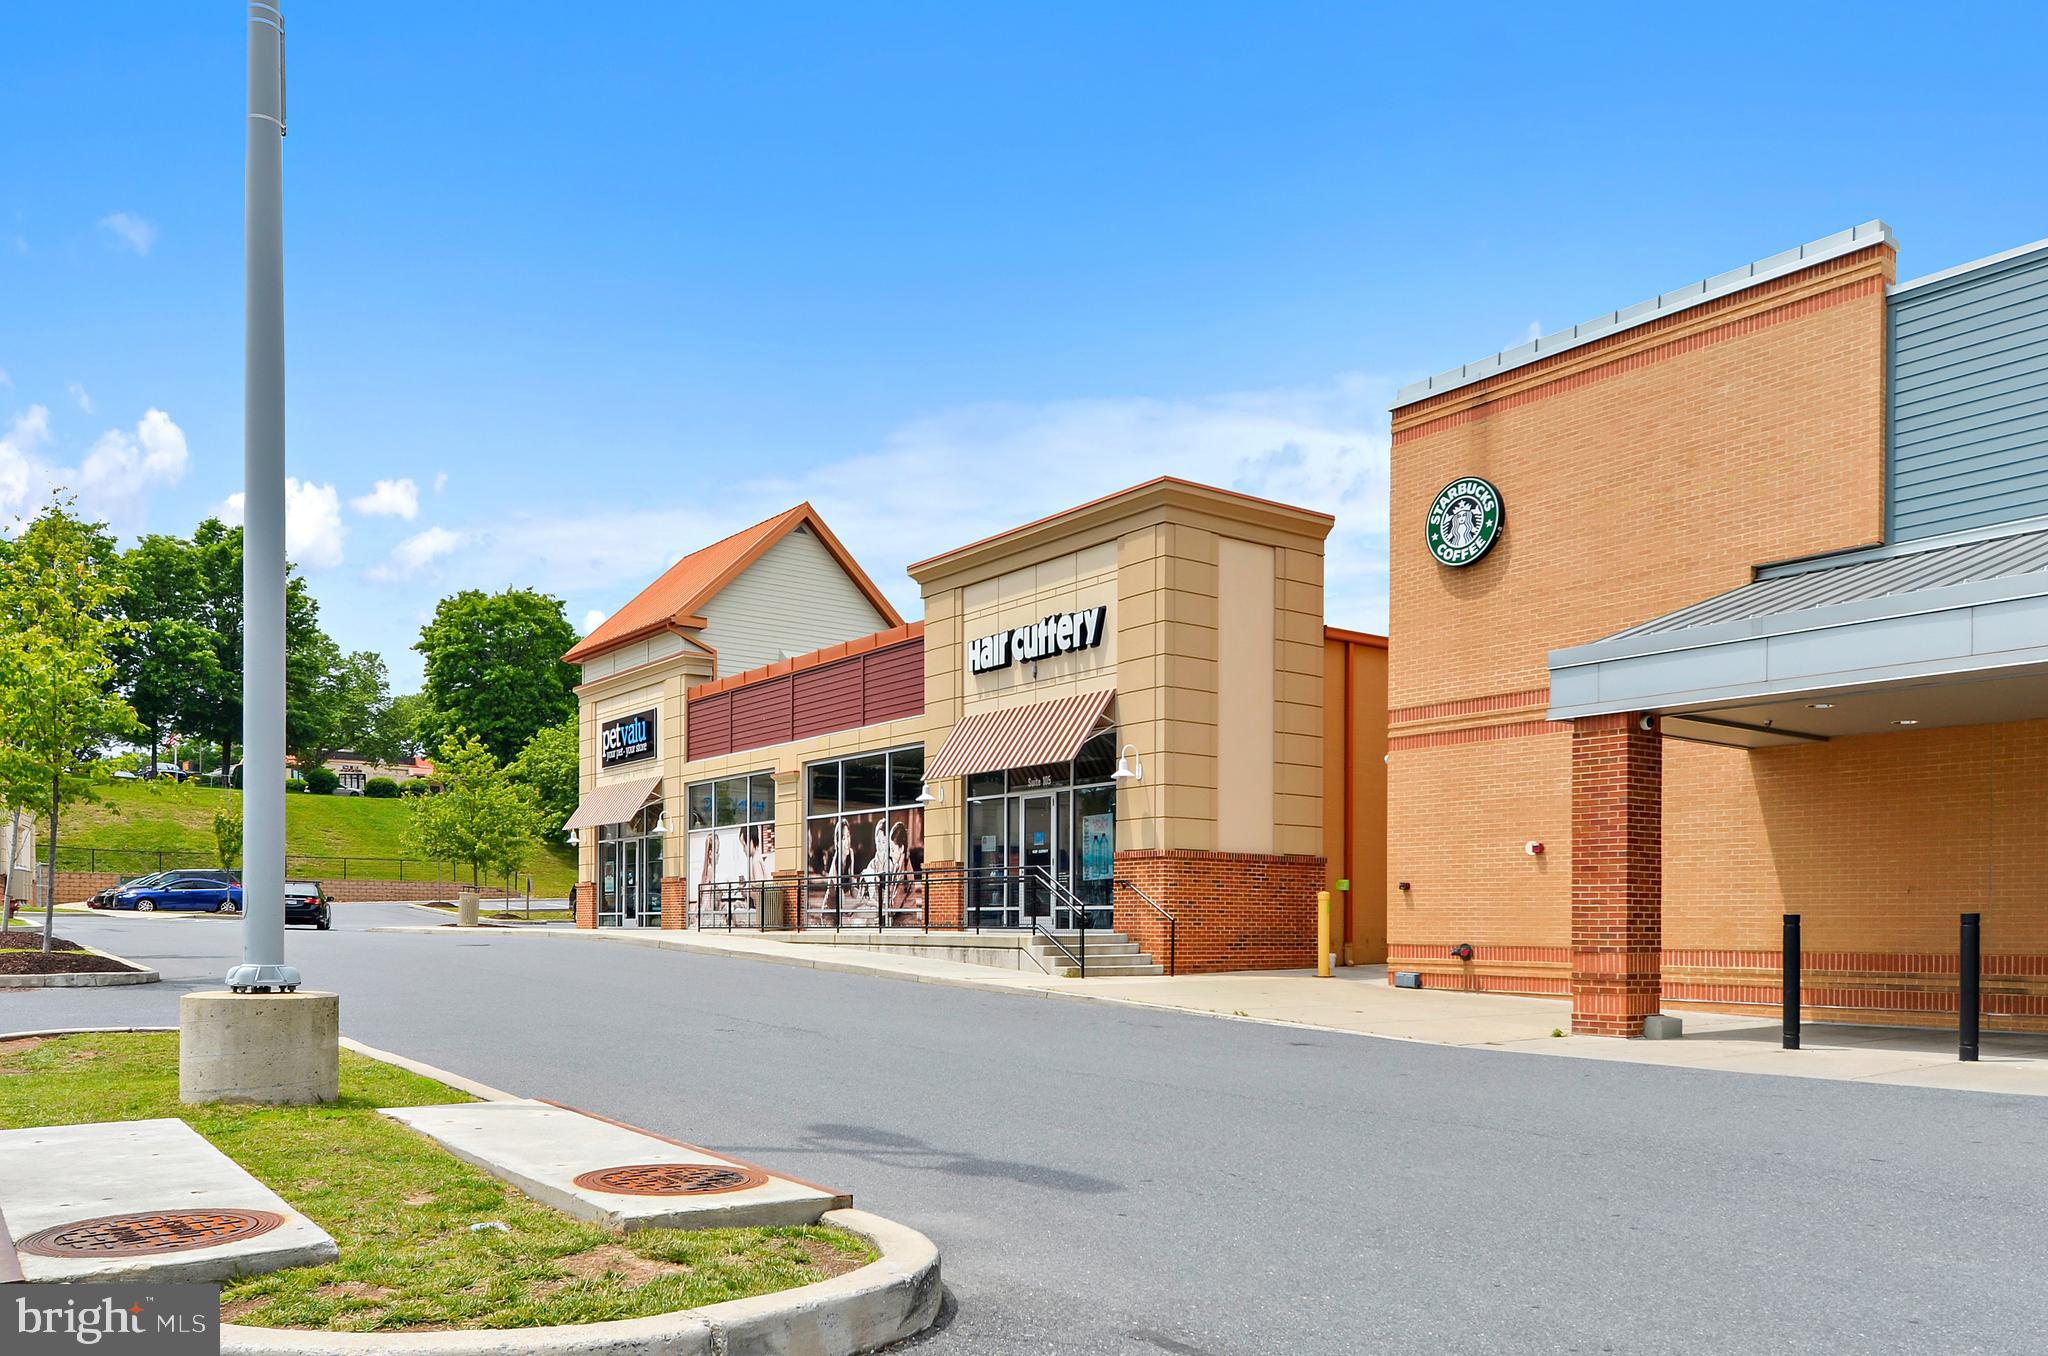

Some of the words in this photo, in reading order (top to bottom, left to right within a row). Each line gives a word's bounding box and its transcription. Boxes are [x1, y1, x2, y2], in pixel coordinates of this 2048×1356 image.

[1431, 482, 1494, 525] STARBUCKS
[1437, 536, 1486, 561] COFFEE
[968, 631, 1009, 673] Hair
[1011, 606, 1101, 661] cuttery
[606, 750, 616, 762] your
[625, 746, 635, 757] your
[636, 743, 647, 752] store
[1028, 777, 1041, 787] Suite
